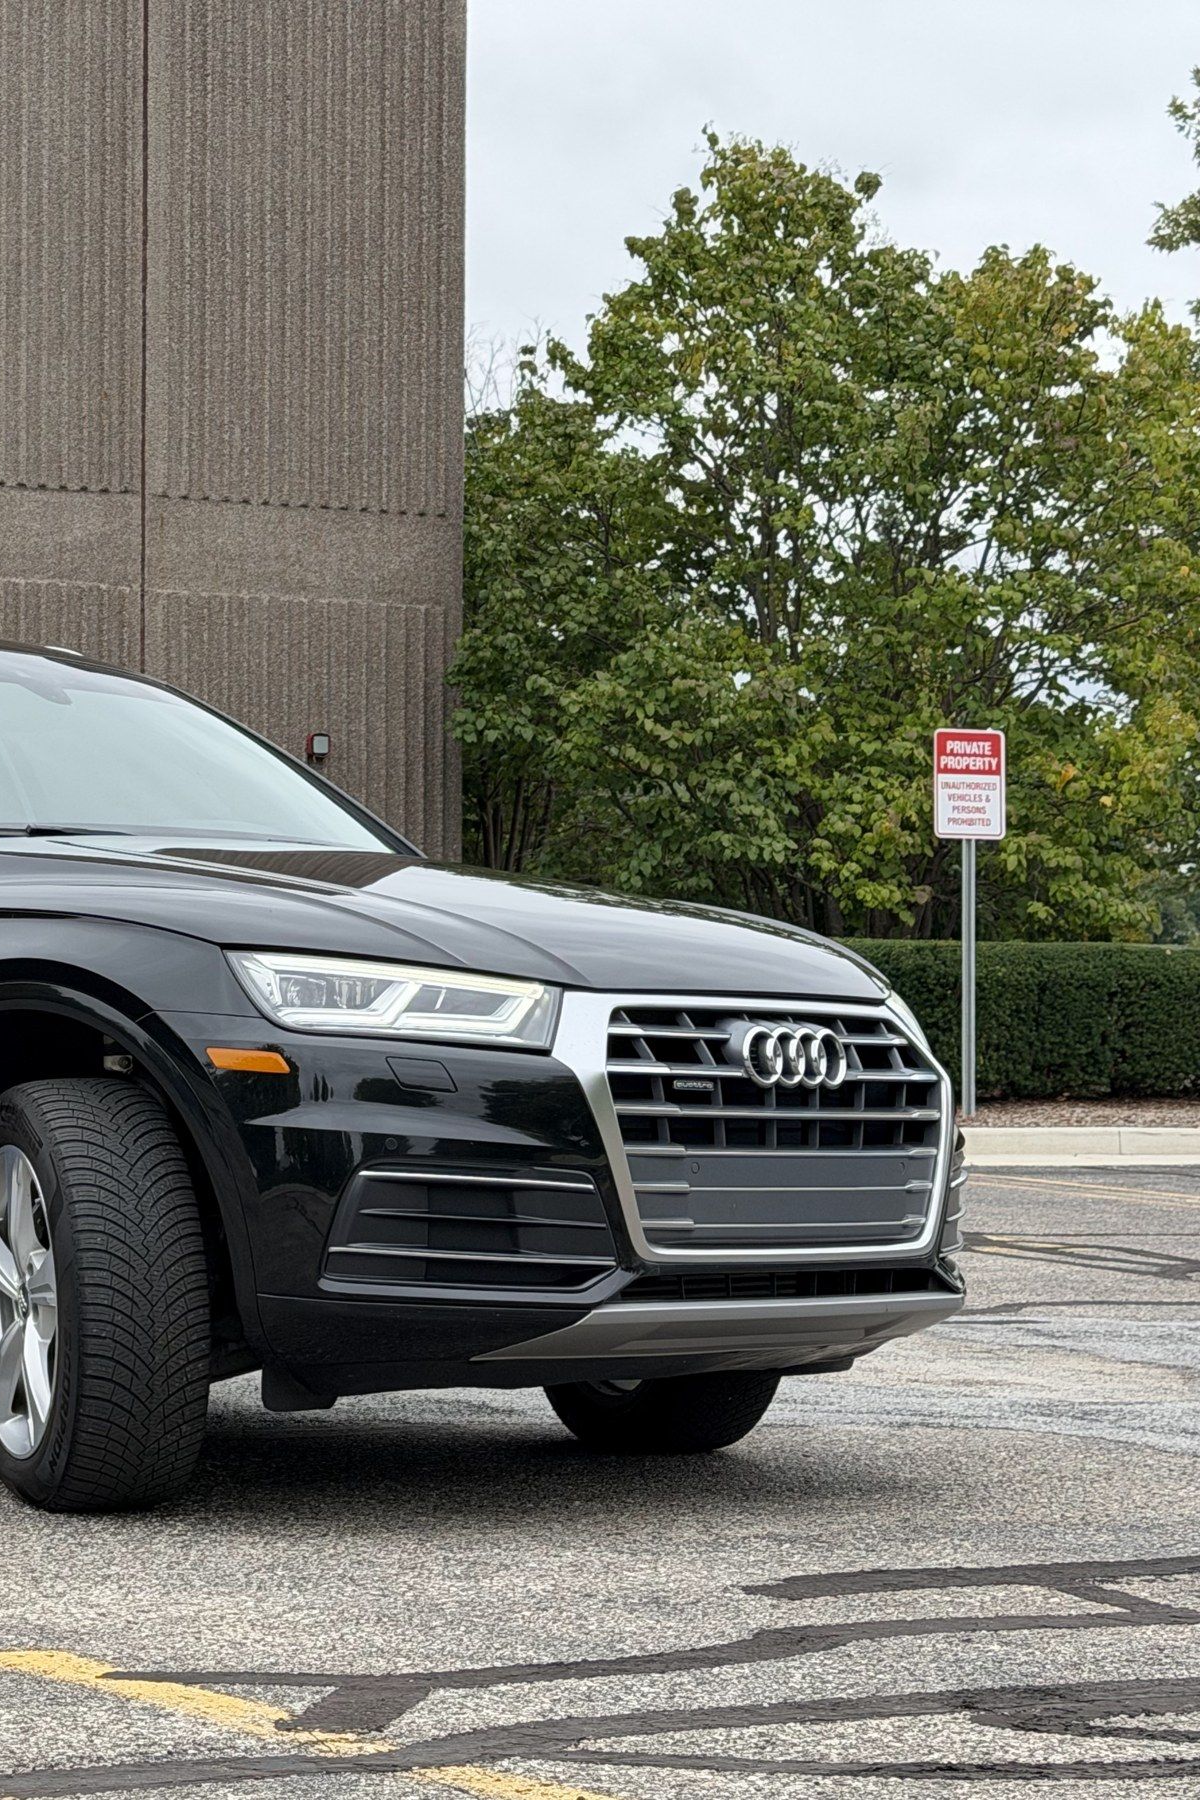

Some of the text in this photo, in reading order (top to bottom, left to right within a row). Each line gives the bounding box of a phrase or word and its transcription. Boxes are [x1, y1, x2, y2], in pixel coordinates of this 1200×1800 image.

[946, 740, 992, 755] PRIVATE
[940, 756, 998, 771] PROPERTY
[940, 781, 997, 792] UNAUTHORIZED
[947, 793, 991, 803] VEHICLES &
[951, 805, 987, 815] PERSONS
[947, 817, 991, 827] PROHIBITED
